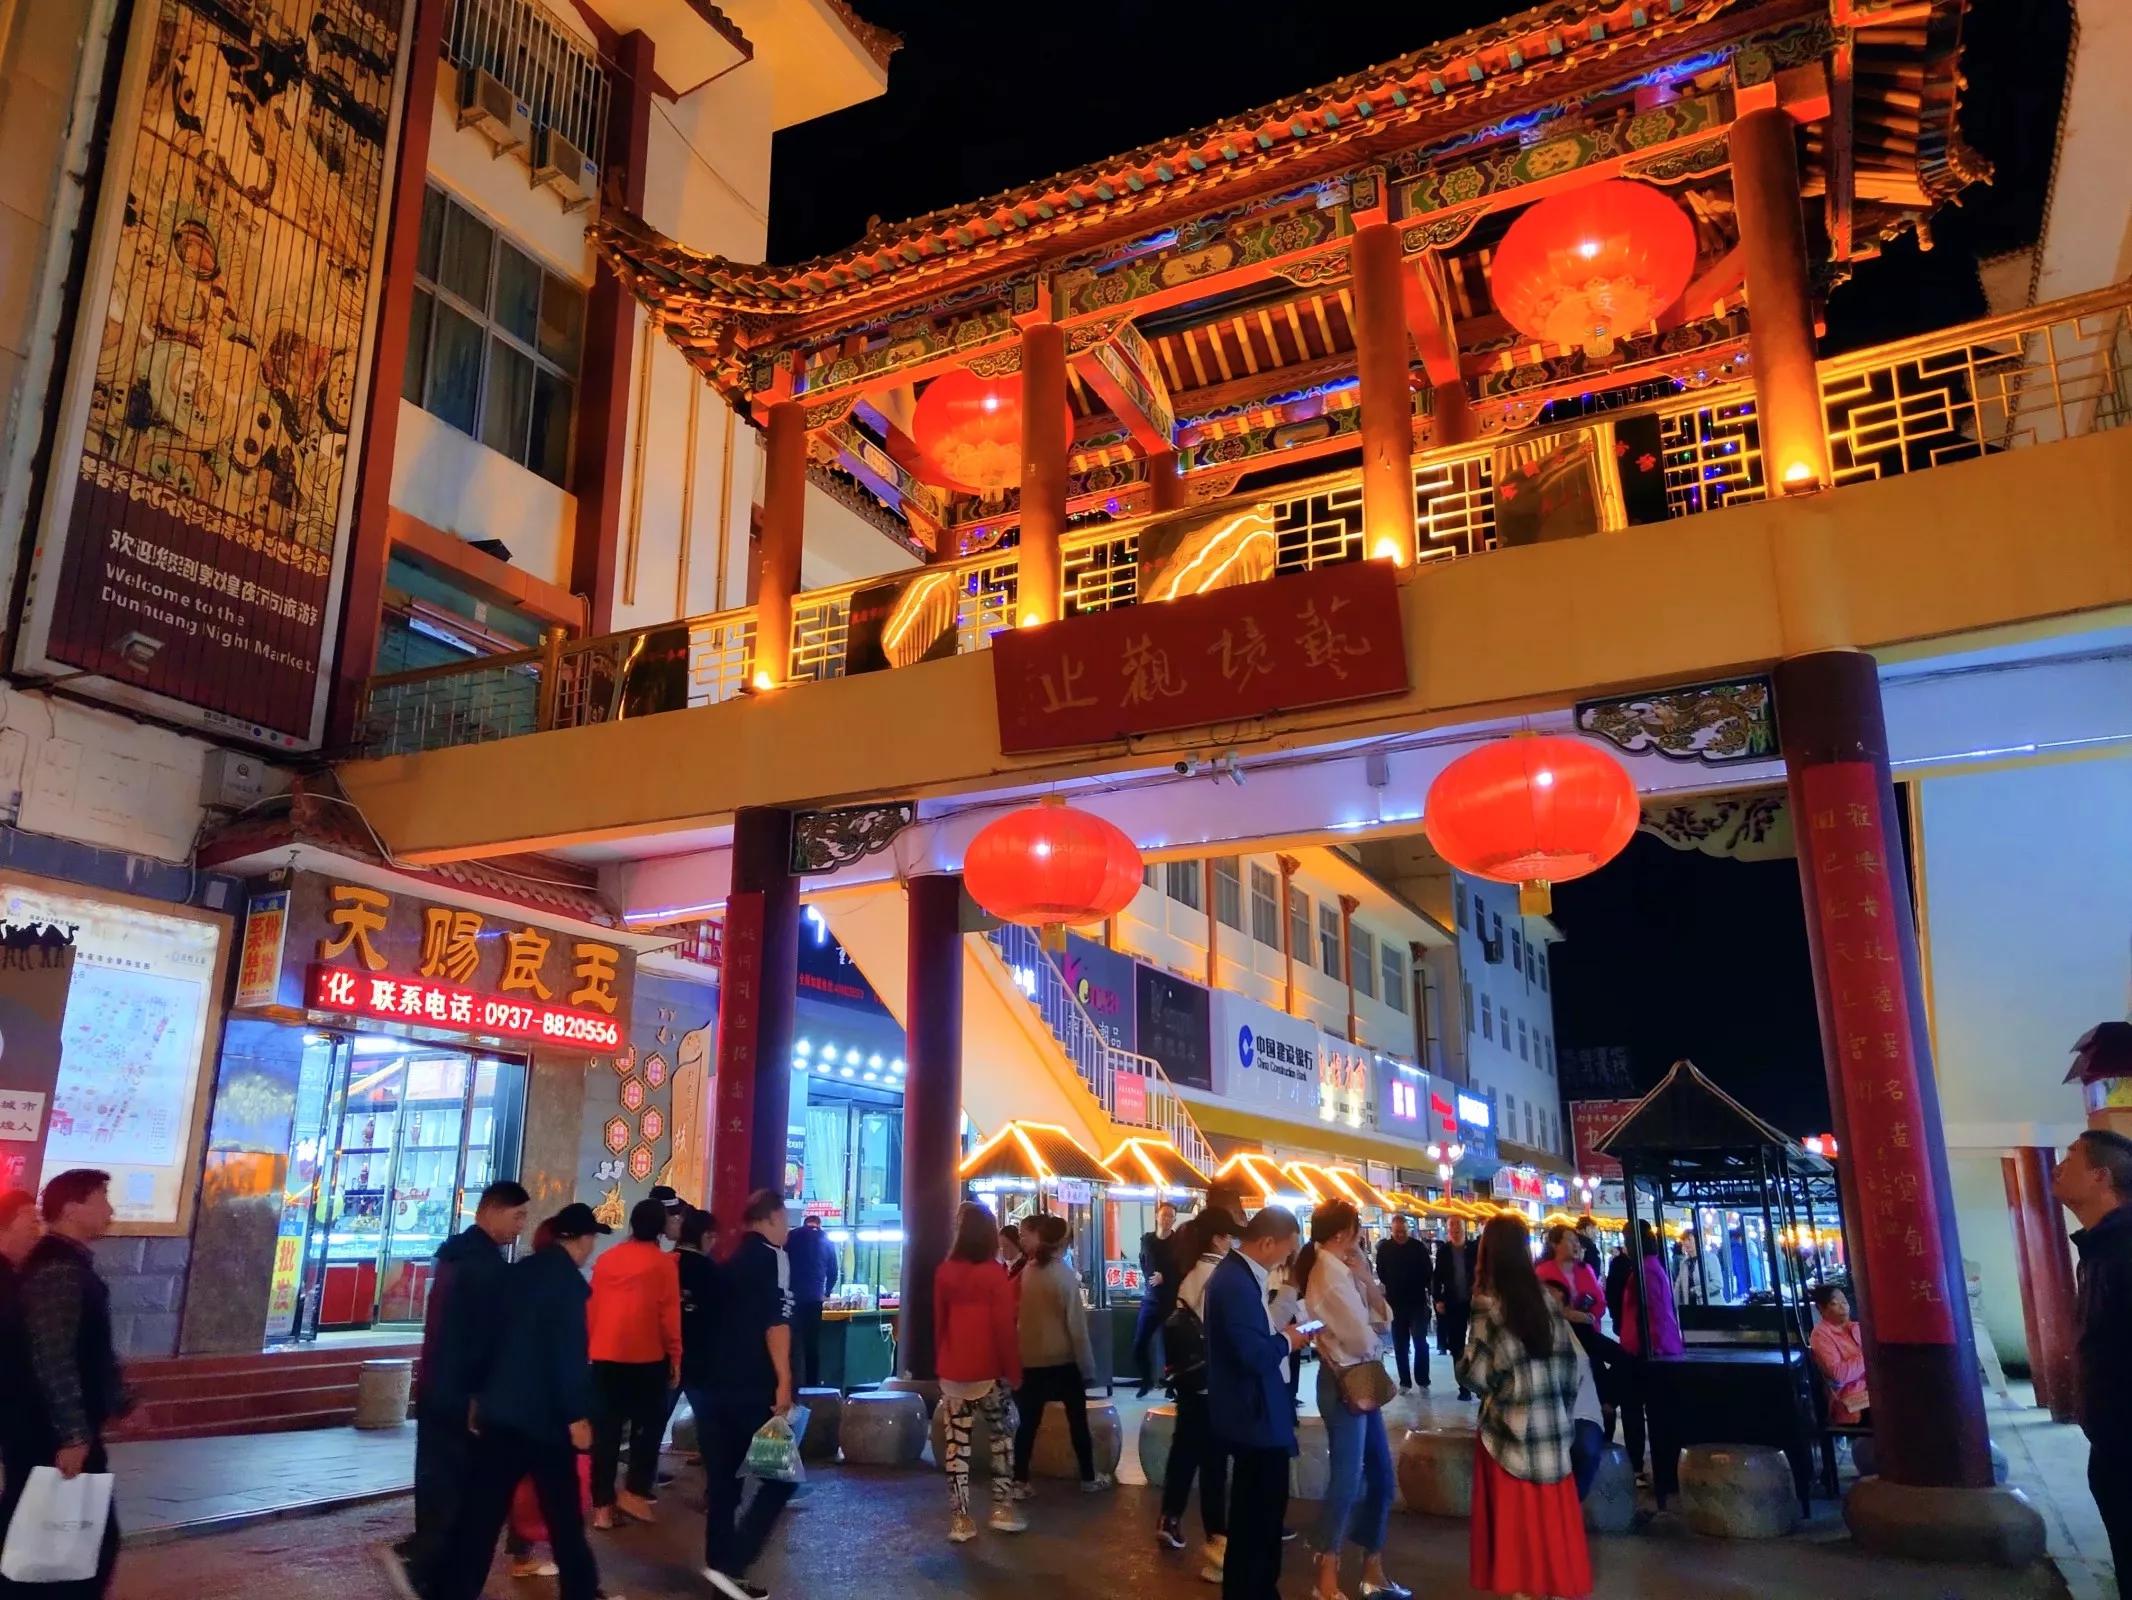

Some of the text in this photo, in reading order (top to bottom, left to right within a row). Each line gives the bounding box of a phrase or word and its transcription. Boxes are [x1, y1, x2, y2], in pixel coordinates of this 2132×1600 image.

[101, 586, 198, 635] Dunhuang
[202, 620, 250, 651] Night
[105, 562, 246, 627] Welcome to the
[322, 884, 620, 1014] 天赐良玉
[1256, 1035, 1313, 1071] 中国建设银行
[1257, 1057, 1269, 1070] China
[1105, 1266, 1140, 1290] 修表
